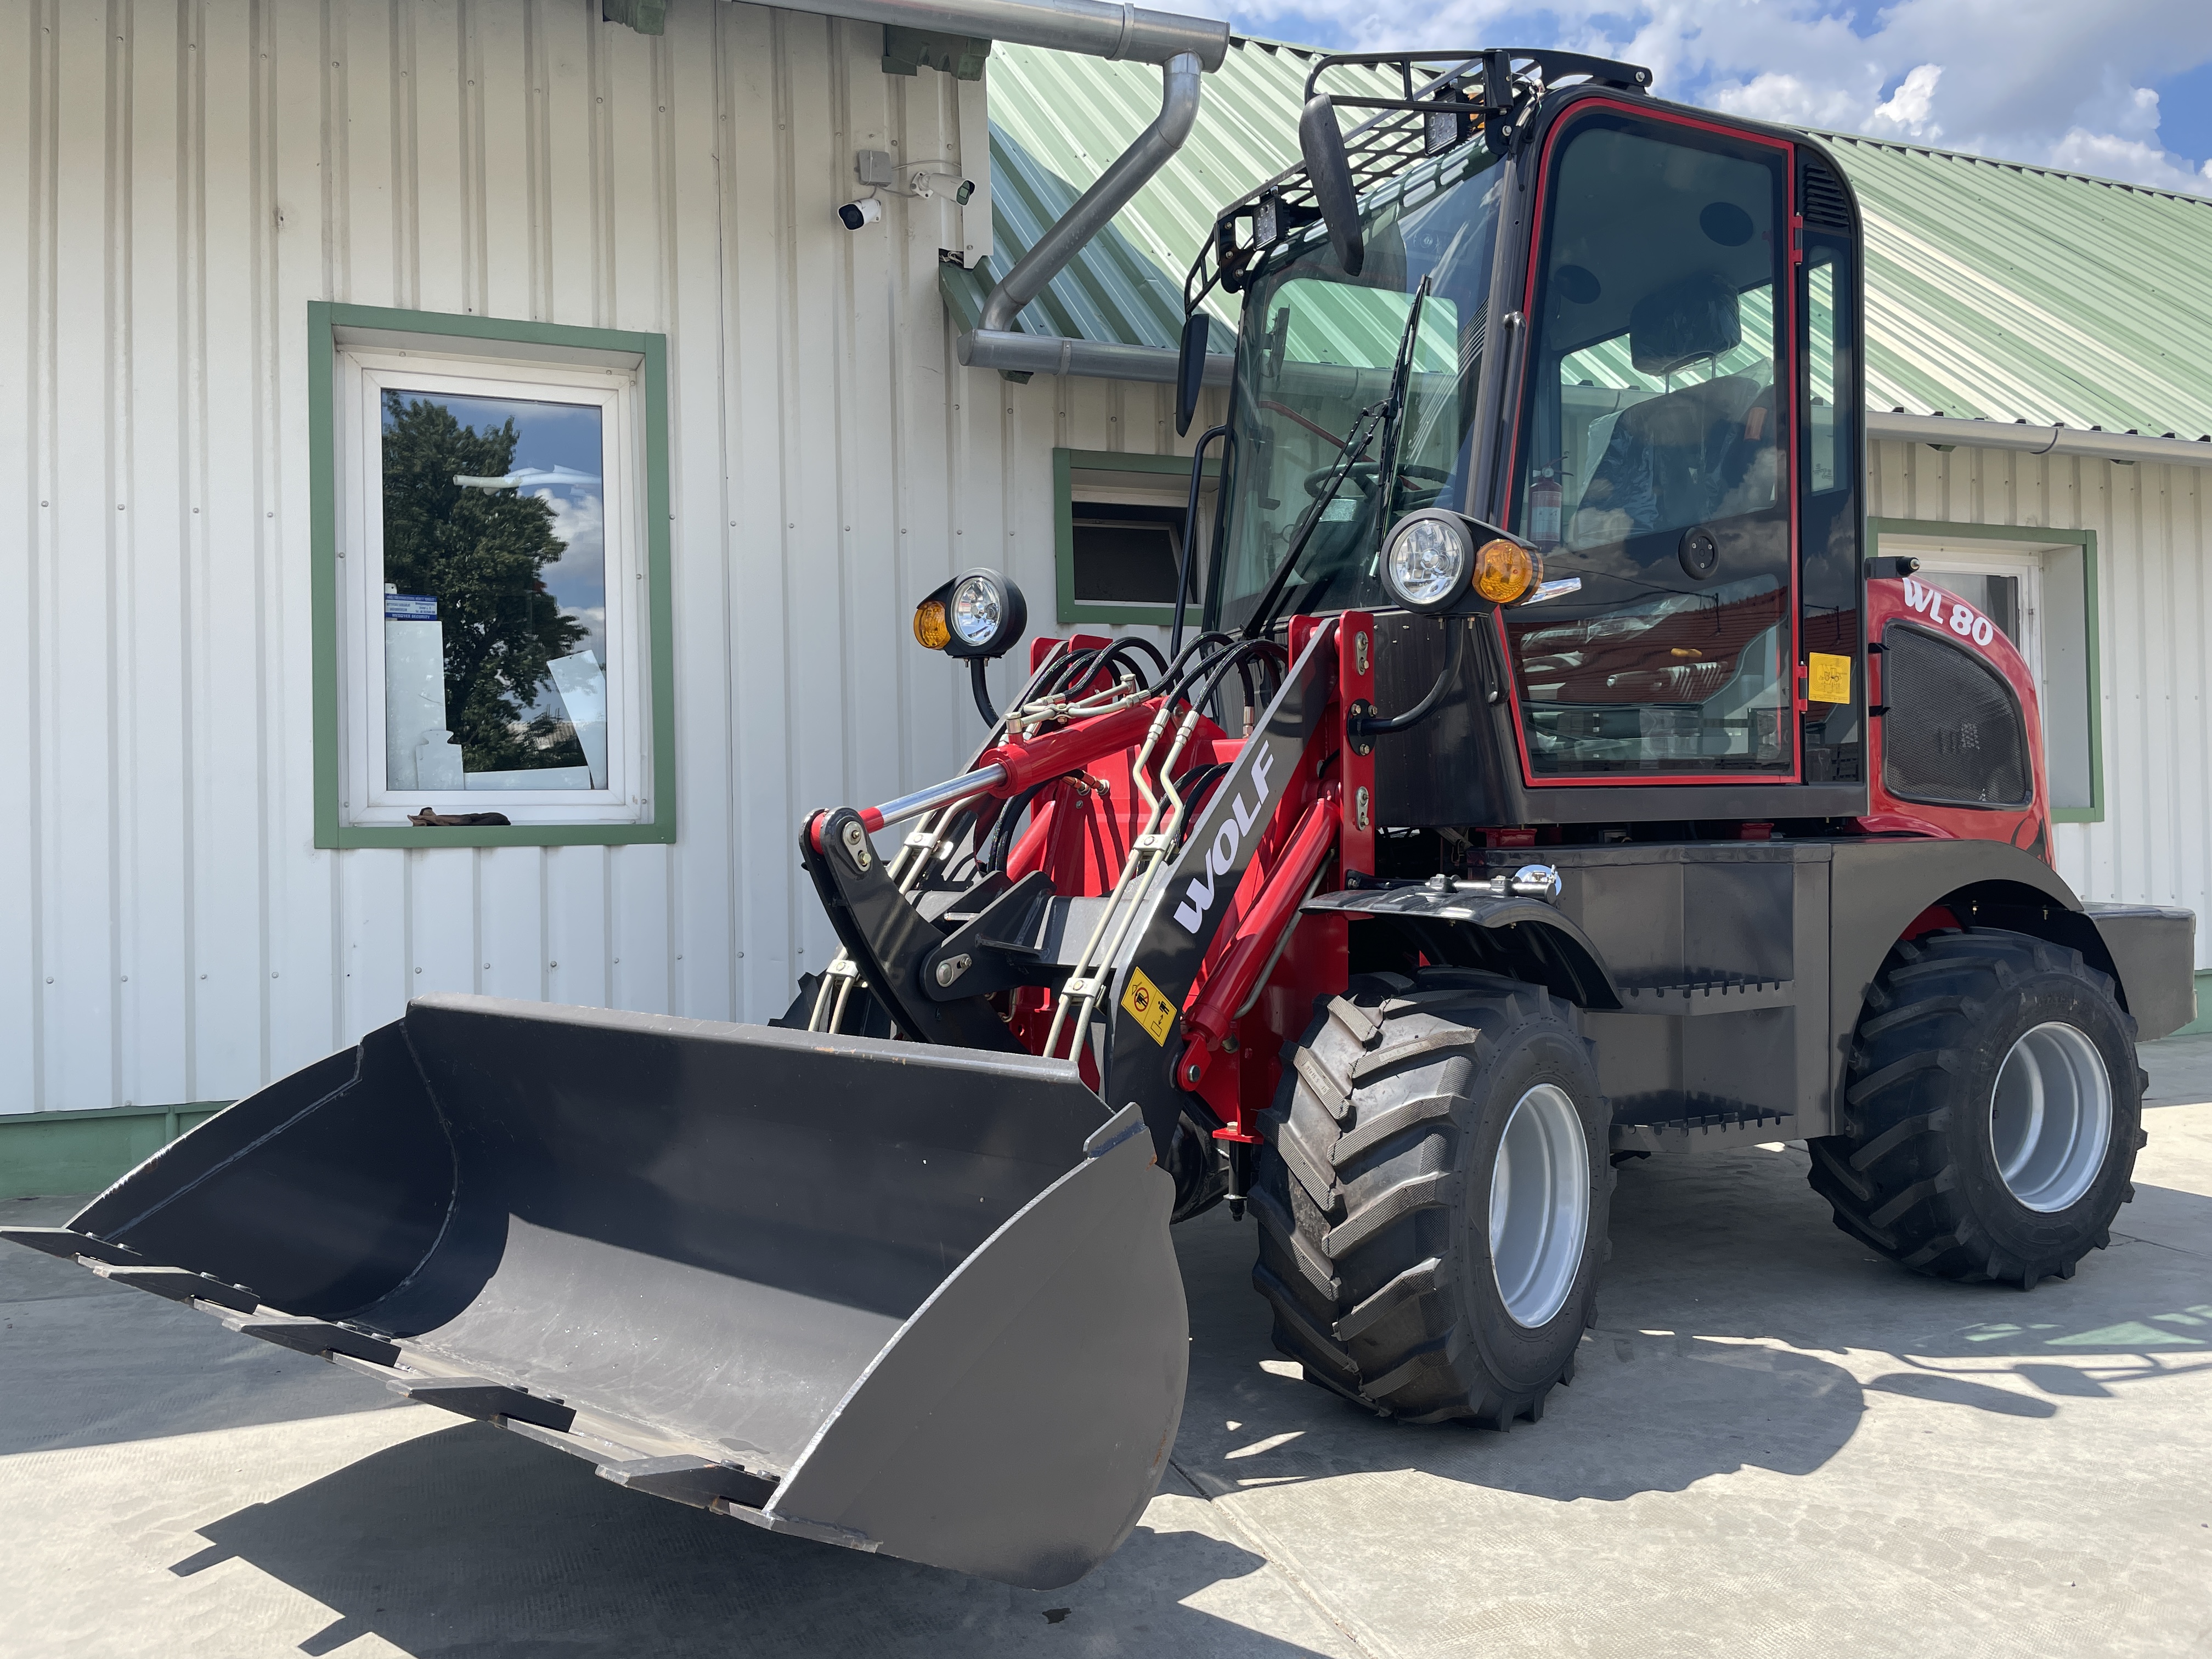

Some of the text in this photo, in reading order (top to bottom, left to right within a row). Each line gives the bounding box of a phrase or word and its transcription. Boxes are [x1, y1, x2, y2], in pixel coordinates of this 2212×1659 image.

[1902, 577, 1993, 646] WL 80
[1173, 740, 1274, 934] WOLF
